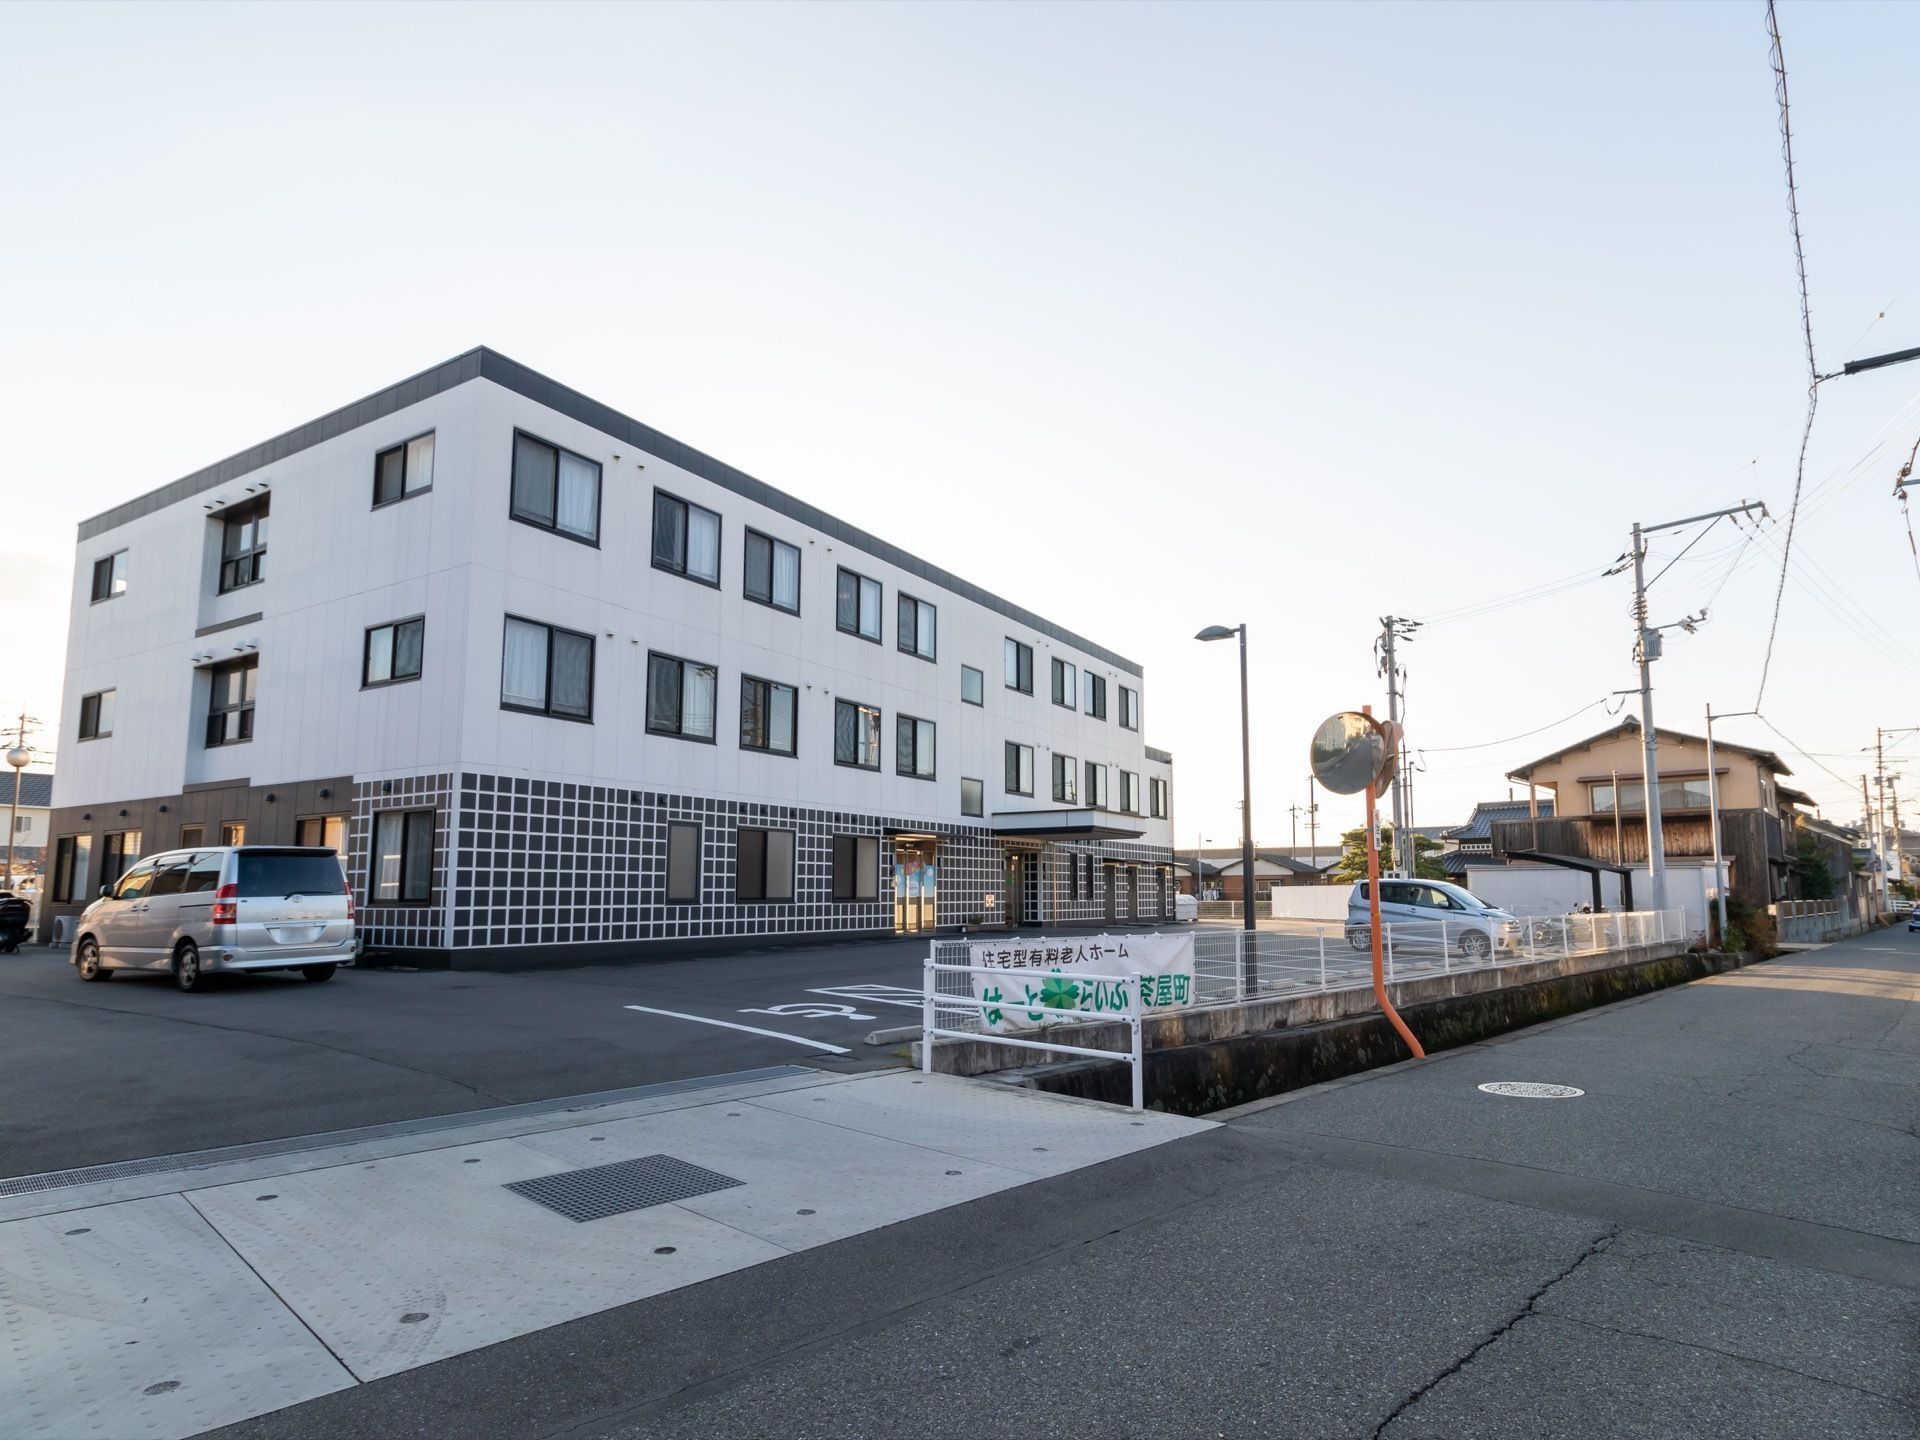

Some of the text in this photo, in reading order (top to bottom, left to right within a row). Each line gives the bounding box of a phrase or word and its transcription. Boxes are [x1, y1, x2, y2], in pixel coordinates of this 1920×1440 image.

[982, 943, 1129, 969] 住宅型有料老人ホーム
